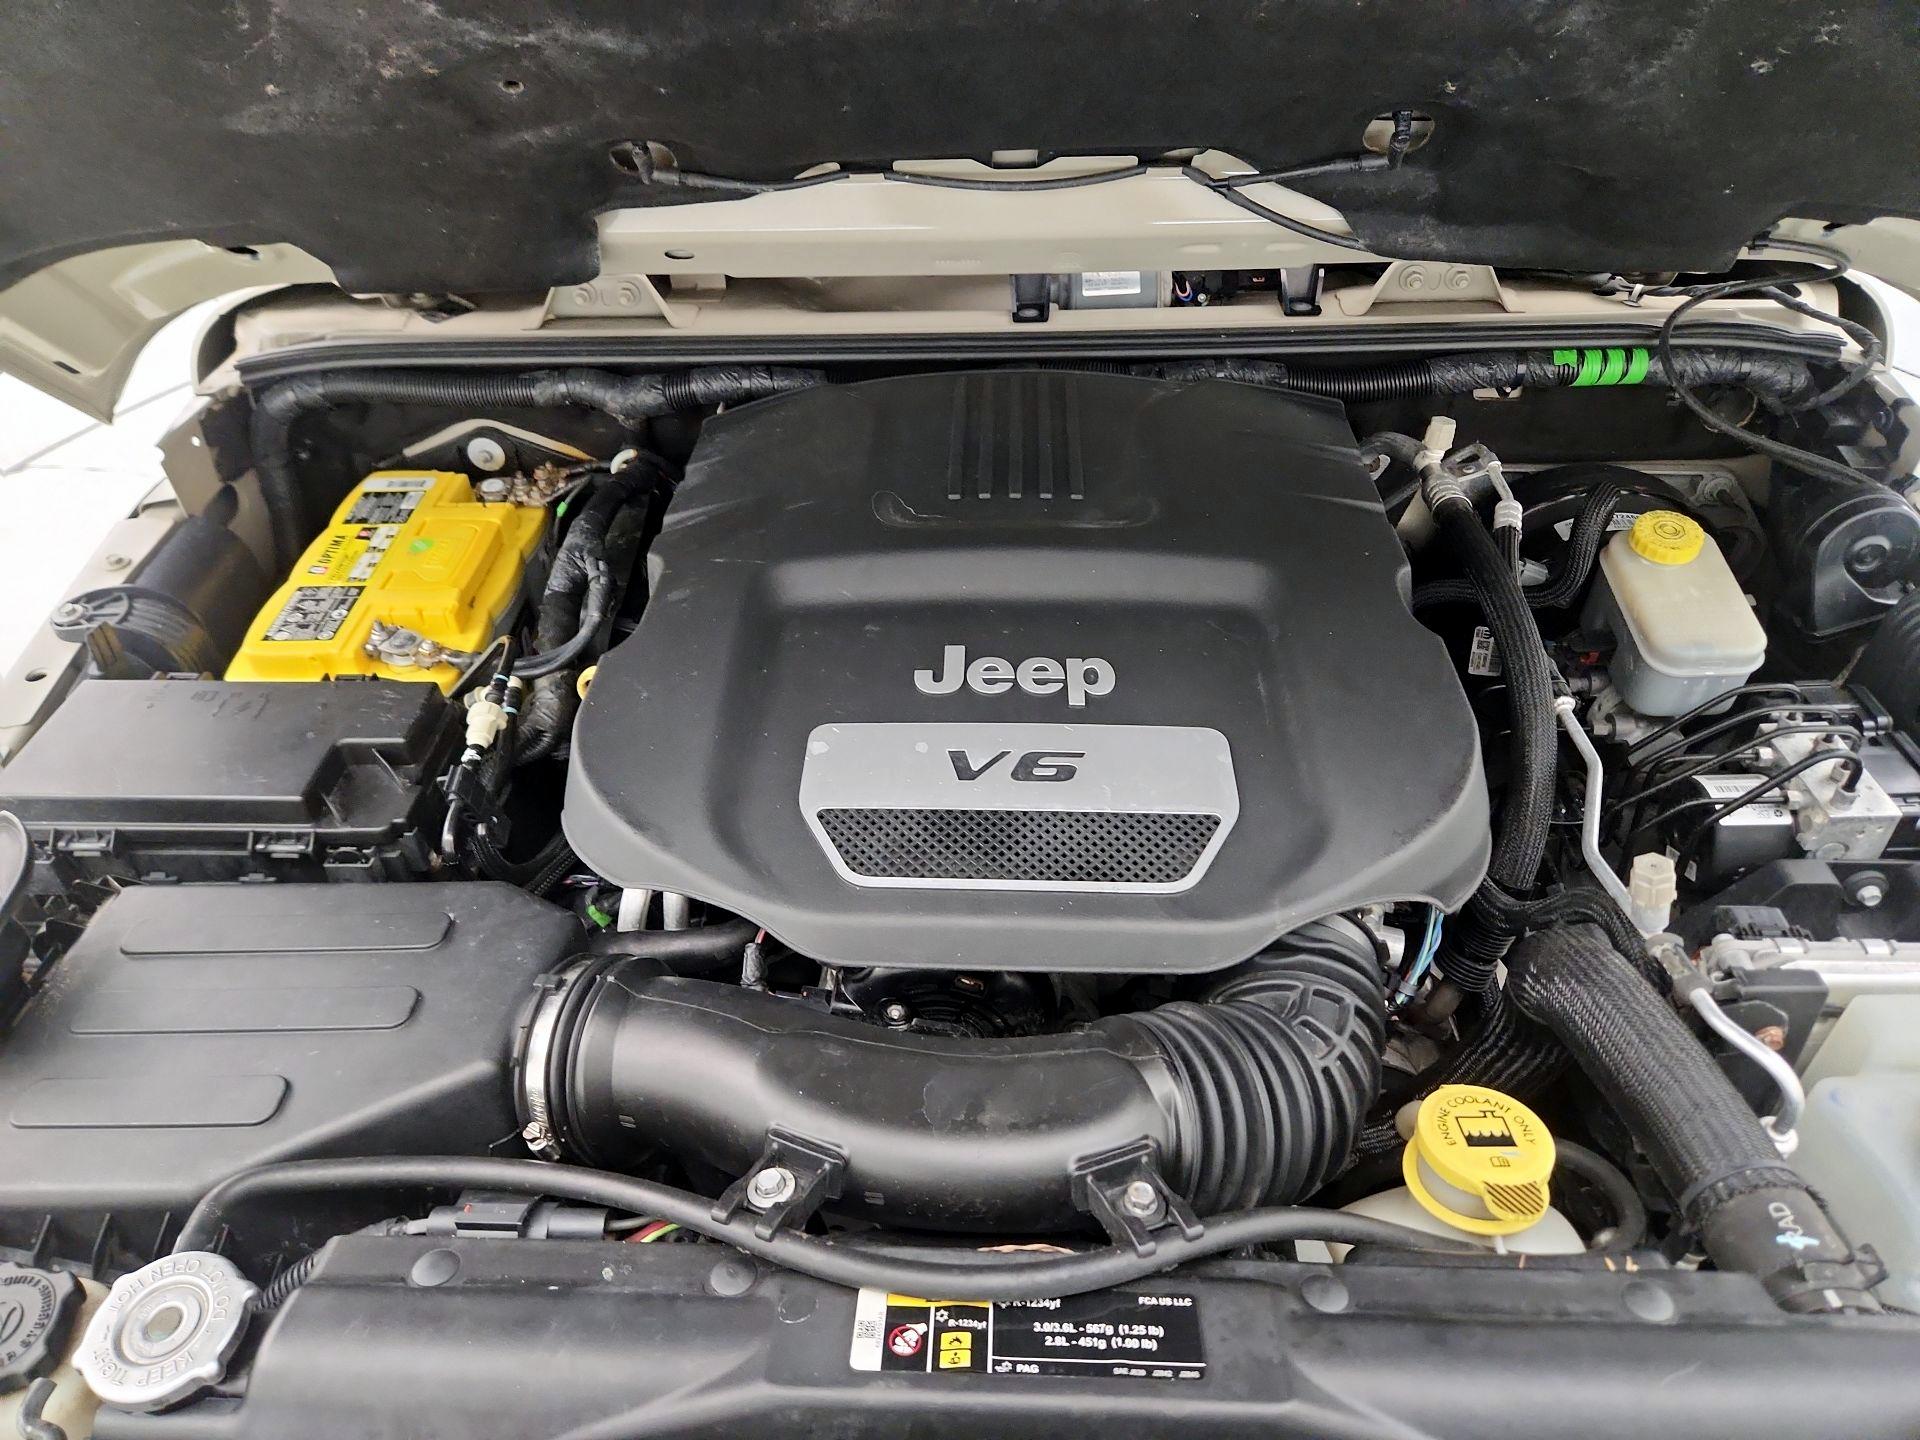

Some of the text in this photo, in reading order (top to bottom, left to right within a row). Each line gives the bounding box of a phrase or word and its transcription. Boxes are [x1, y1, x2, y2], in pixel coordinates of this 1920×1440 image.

[318, 534, 346, 564] OPTIMA
[914, 645, 1116, 706] Jeep
[947, 750, 1086, 782] V6
[1437, 1095, 1536, 1146] ENGINE COOLANT ONLY
[151, 1259, 201, 1283] OPEN
[1138, 1296, 1192, 1307] FCA US LLC
[1148, 1325, 1164, 1338] lb)
[1140, 1338, 1158, 1351] lb)
[1016, 1363, 1040, 1374] PAG
